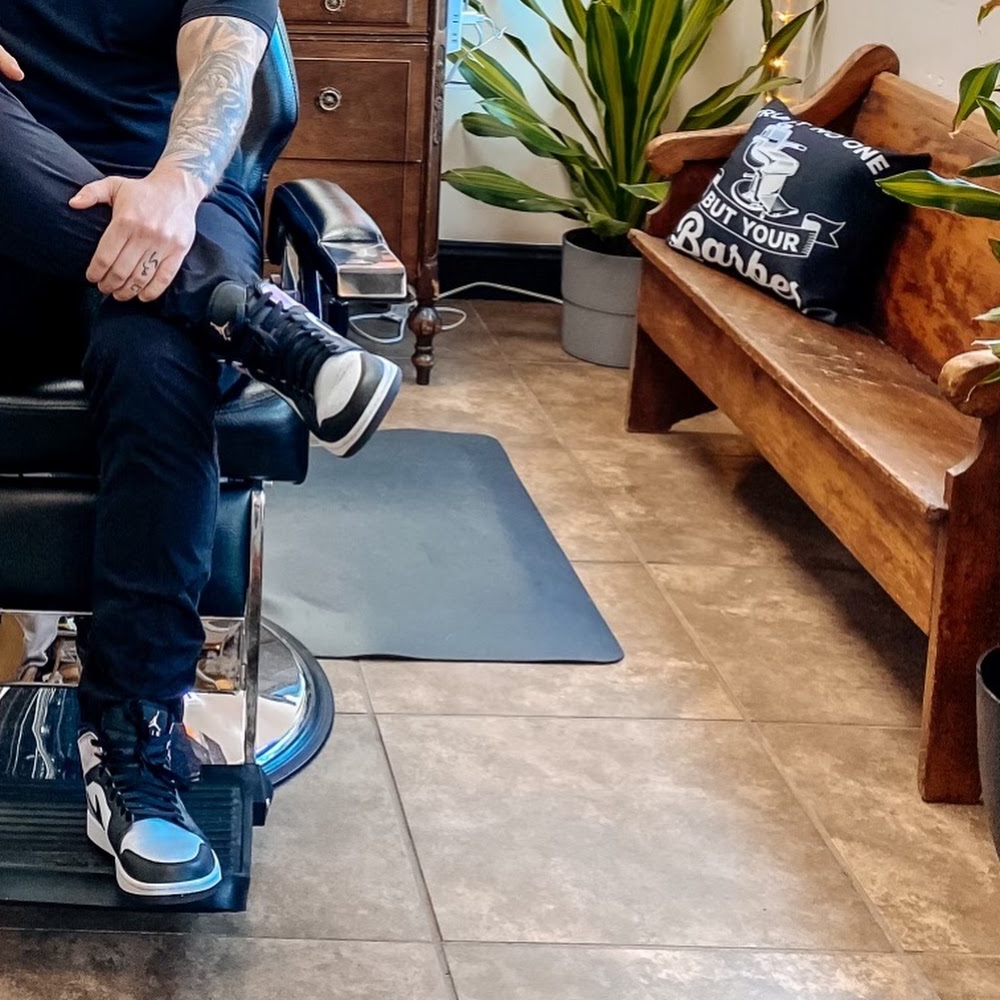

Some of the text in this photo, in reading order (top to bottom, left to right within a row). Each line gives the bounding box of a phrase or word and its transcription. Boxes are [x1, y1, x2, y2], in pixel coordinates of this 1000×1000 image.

[842, 139, 890, 175] ONE
[701, 190, 801, 252] BUT YOUR
